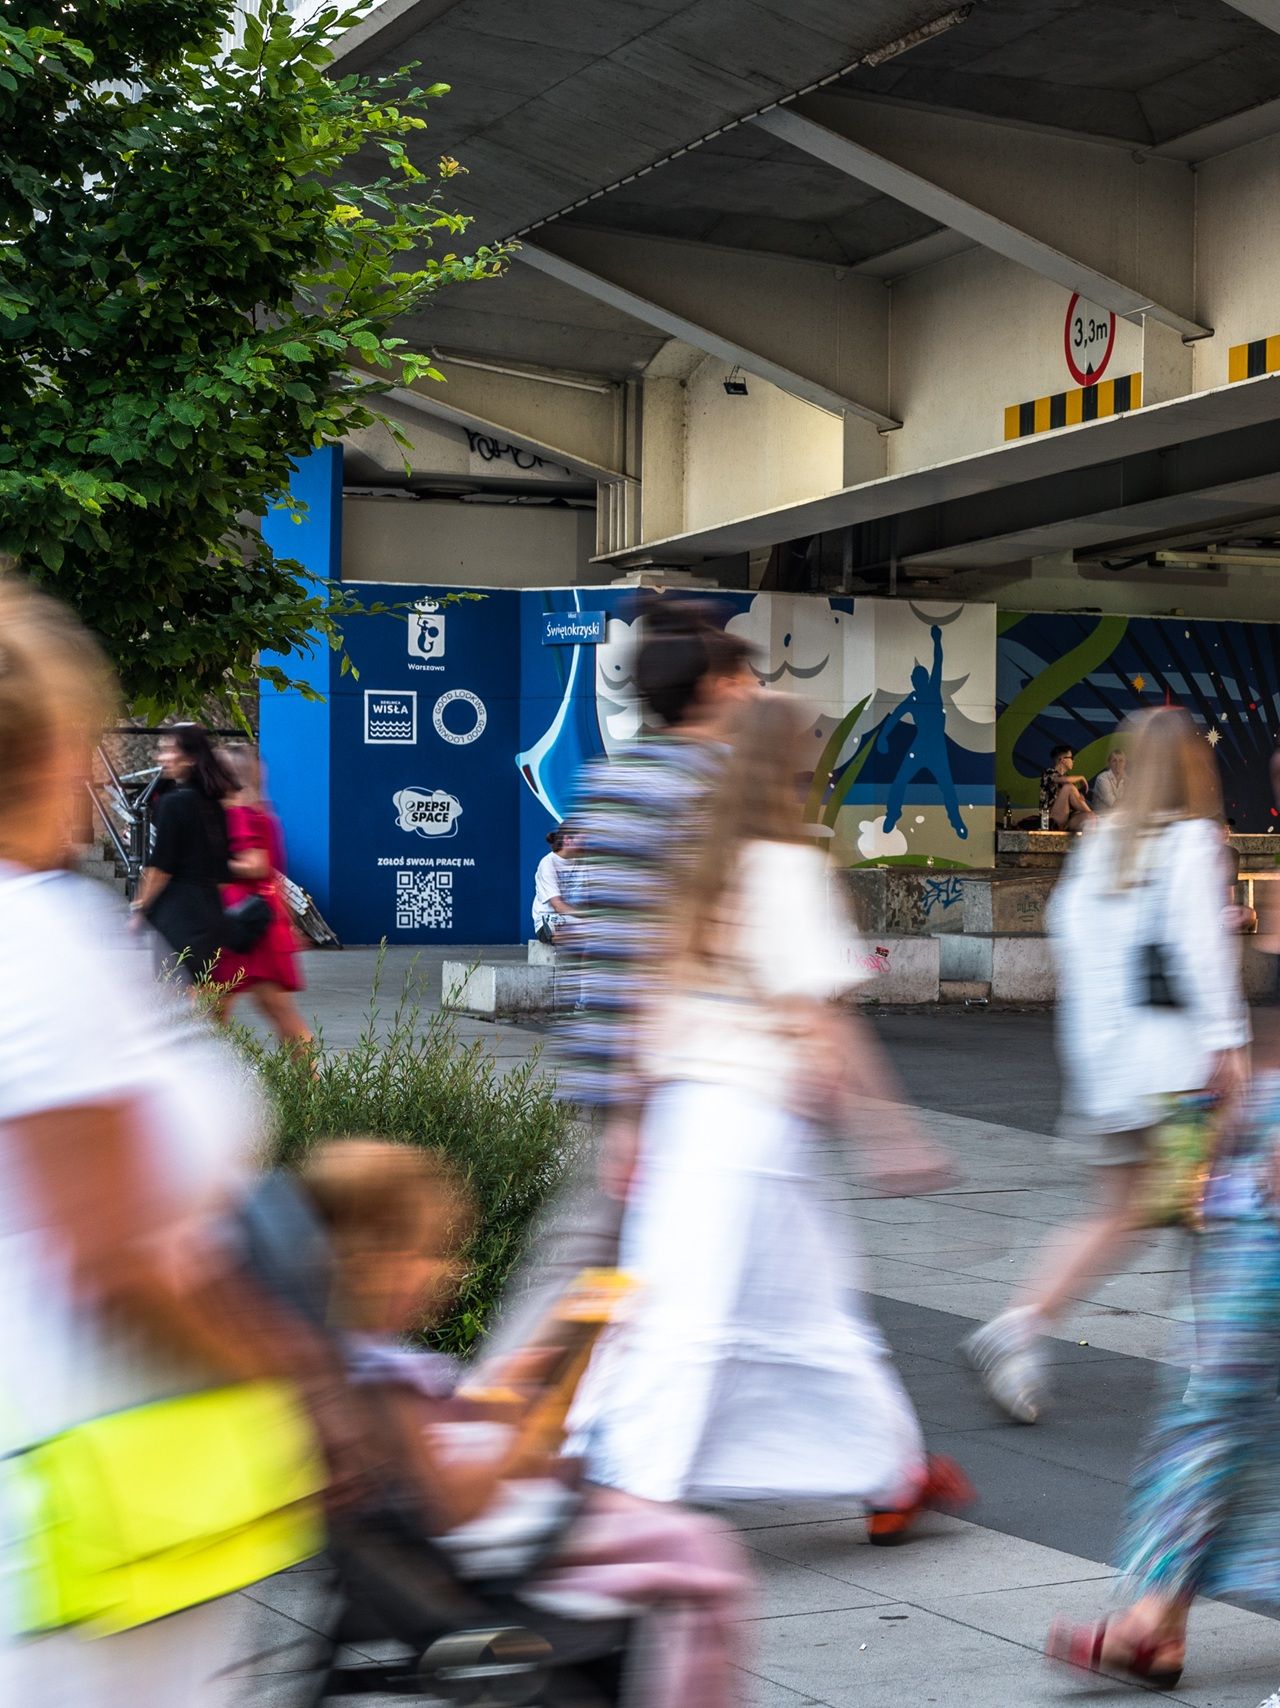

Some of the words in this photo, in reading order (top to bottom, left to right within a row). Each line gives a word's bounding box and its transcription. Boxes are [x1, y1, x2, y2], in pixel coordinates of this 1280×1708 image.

[1073, 316, 1109, 349] 3,3m
[546, 620, 600, 640] Świętokrzyski
[407, 662, 446, 672] Warszawa
[372, 704, 409, 714] WISŁA
[434, 692, 453, 715] GOOD
[454, 690, 485, 716] LOOKING
[434, 718, 465, 744] LOOKING
[466, 719, 485, 742] GOOD
[416, 800, 450, 812] PEPSI
[411, 812, 449, 823] SPACE
[377, 855, 404, 866] ZGŁOŚ
[405, 857, 435, 867] SWOJĄ
[435, 857, 462, 868] PRACĘ
[462, 858, 475, 867] NA
